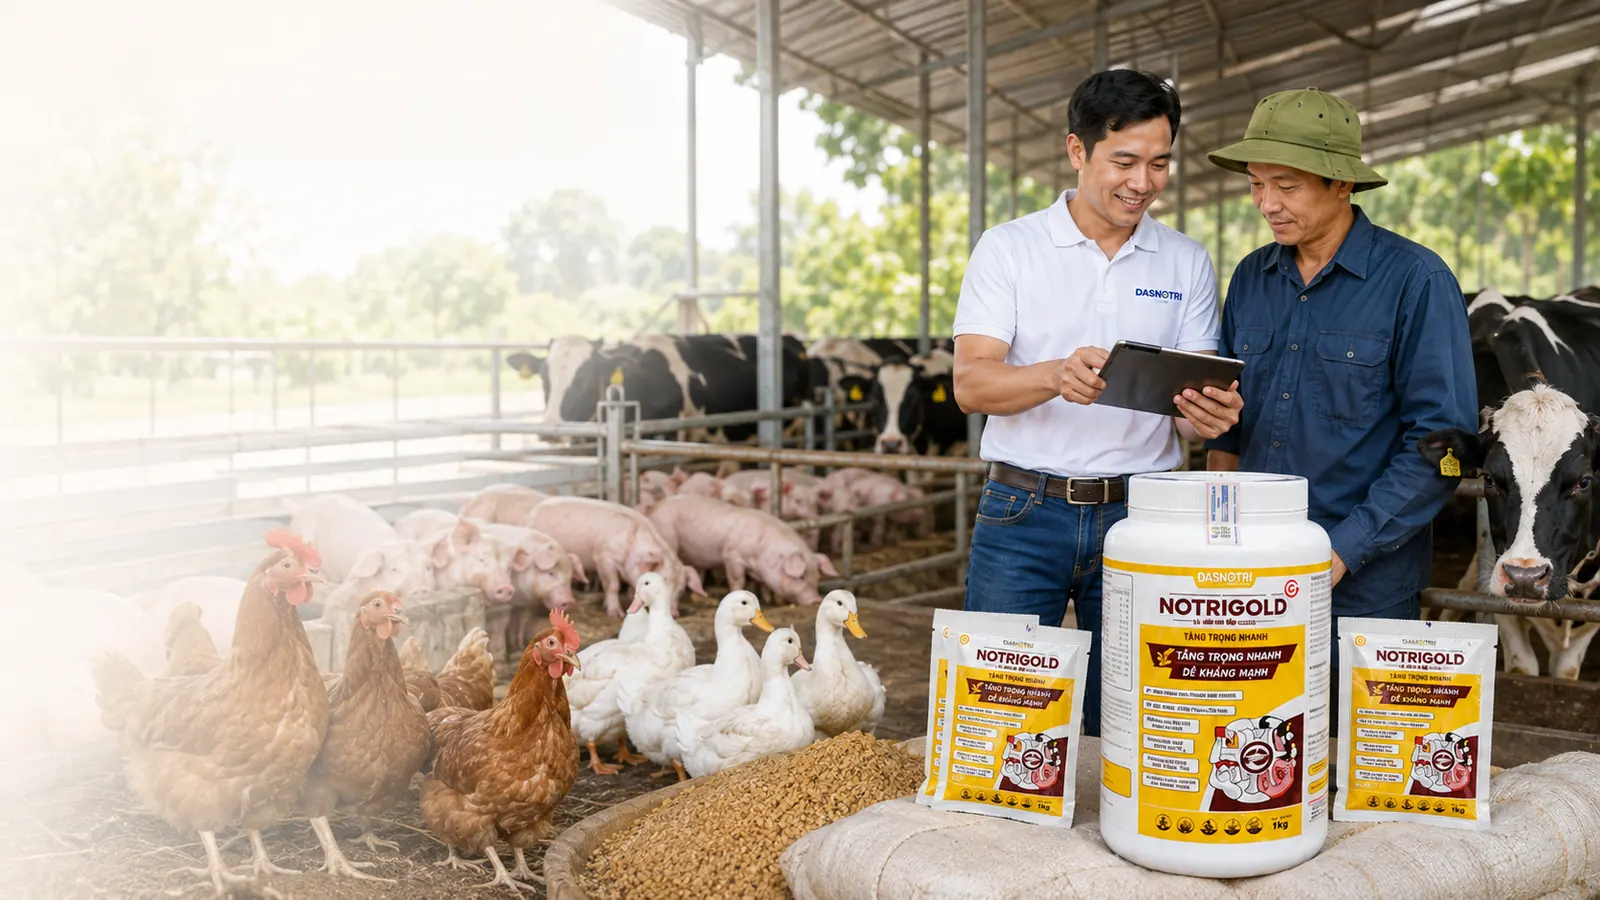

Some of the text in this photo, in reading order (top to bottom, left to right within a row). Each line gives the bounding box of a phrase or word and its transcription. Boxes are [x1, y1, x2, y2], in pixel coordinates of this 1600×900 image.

[1135, 288, 1183, 301] DASNOTRI
[1197, 571, 1253, 583] DASNOTRI
[1159, 597, 1288, 616] NOTRIGOLD
[1238, 633, 1268, 641] NHANH
[976, 648, 1060, 670] NOTRIGOLD
[1246, 650, 1282, 660] NHANH
[1376, 649, 1465, 665] NOTRIGOLD
[1272, 820, 1289, 830] 1kg
